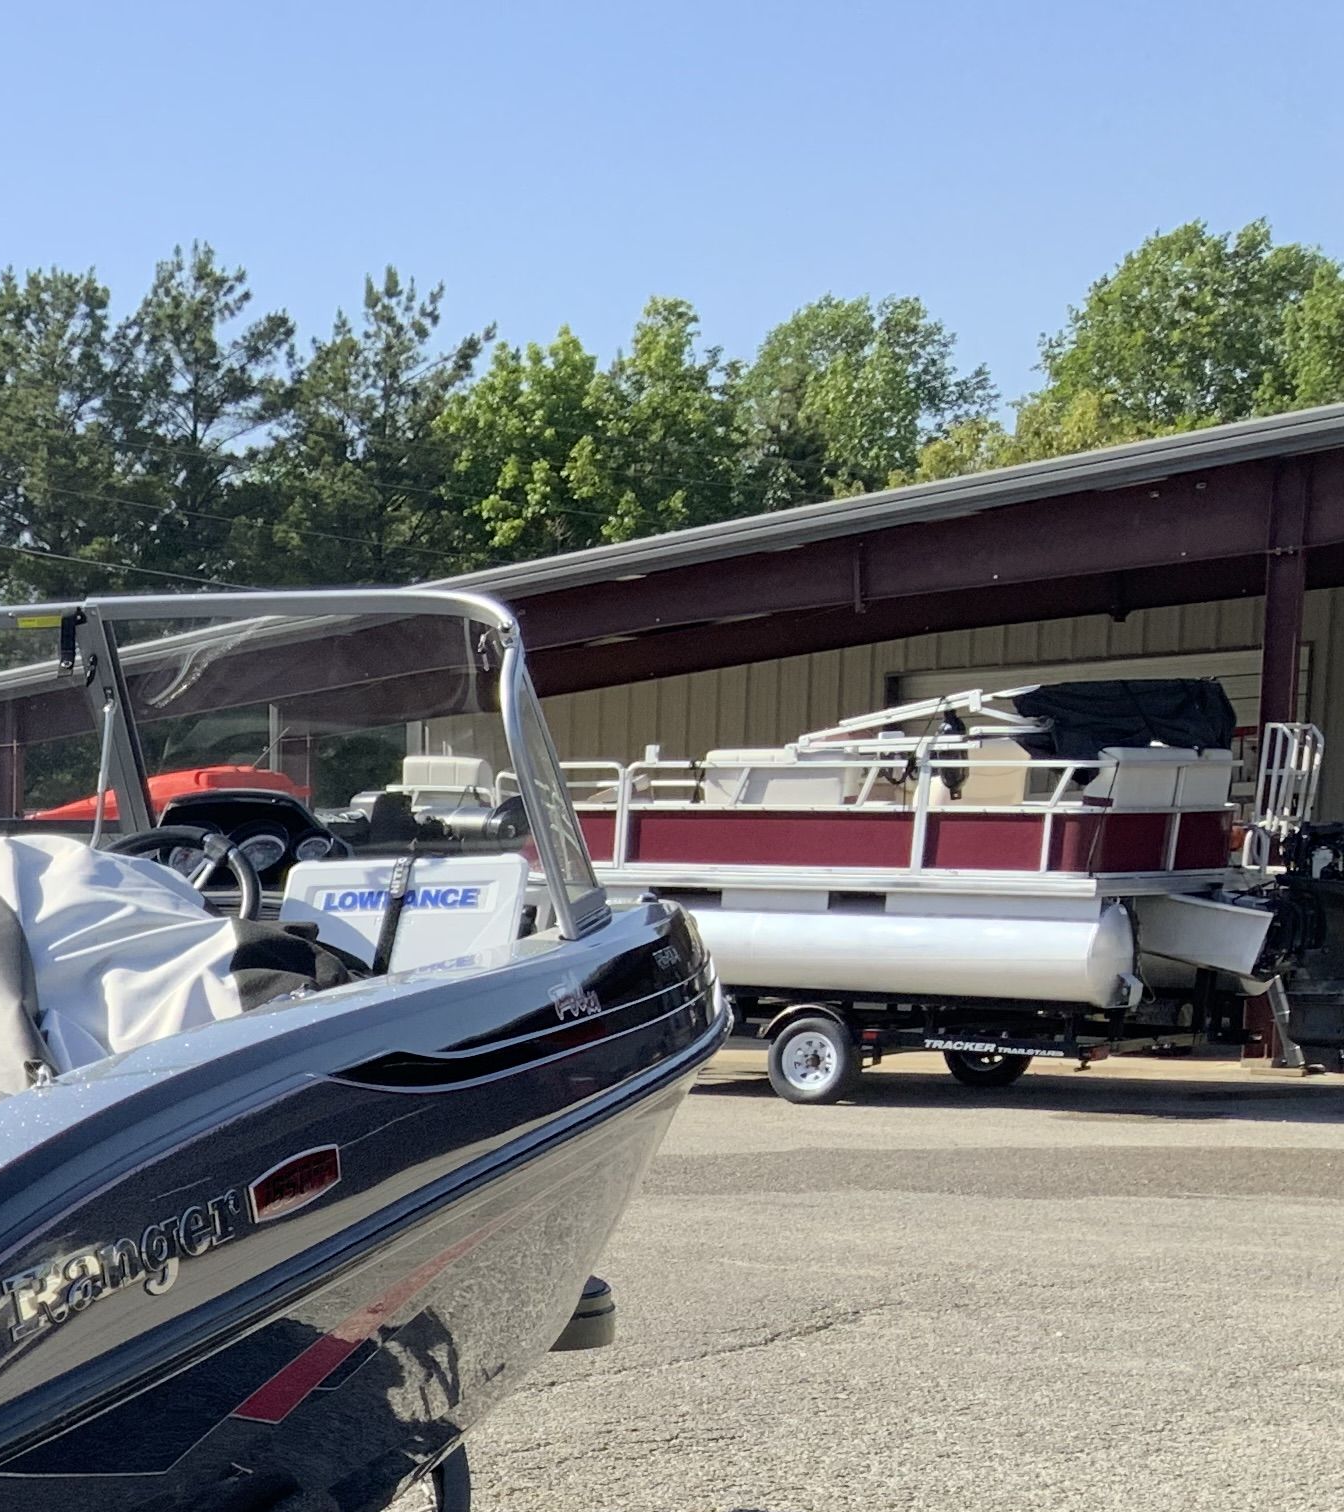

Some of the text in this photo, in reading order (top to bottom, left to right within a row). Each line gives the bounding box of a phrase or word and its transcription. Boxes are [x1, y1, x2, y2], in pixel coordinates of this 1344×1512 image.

[322, 887, 481, 912] LOWANCE
[924, 1039, 996, 1053] TRACKER
[1, 1188, 241, 1343] Ranger
